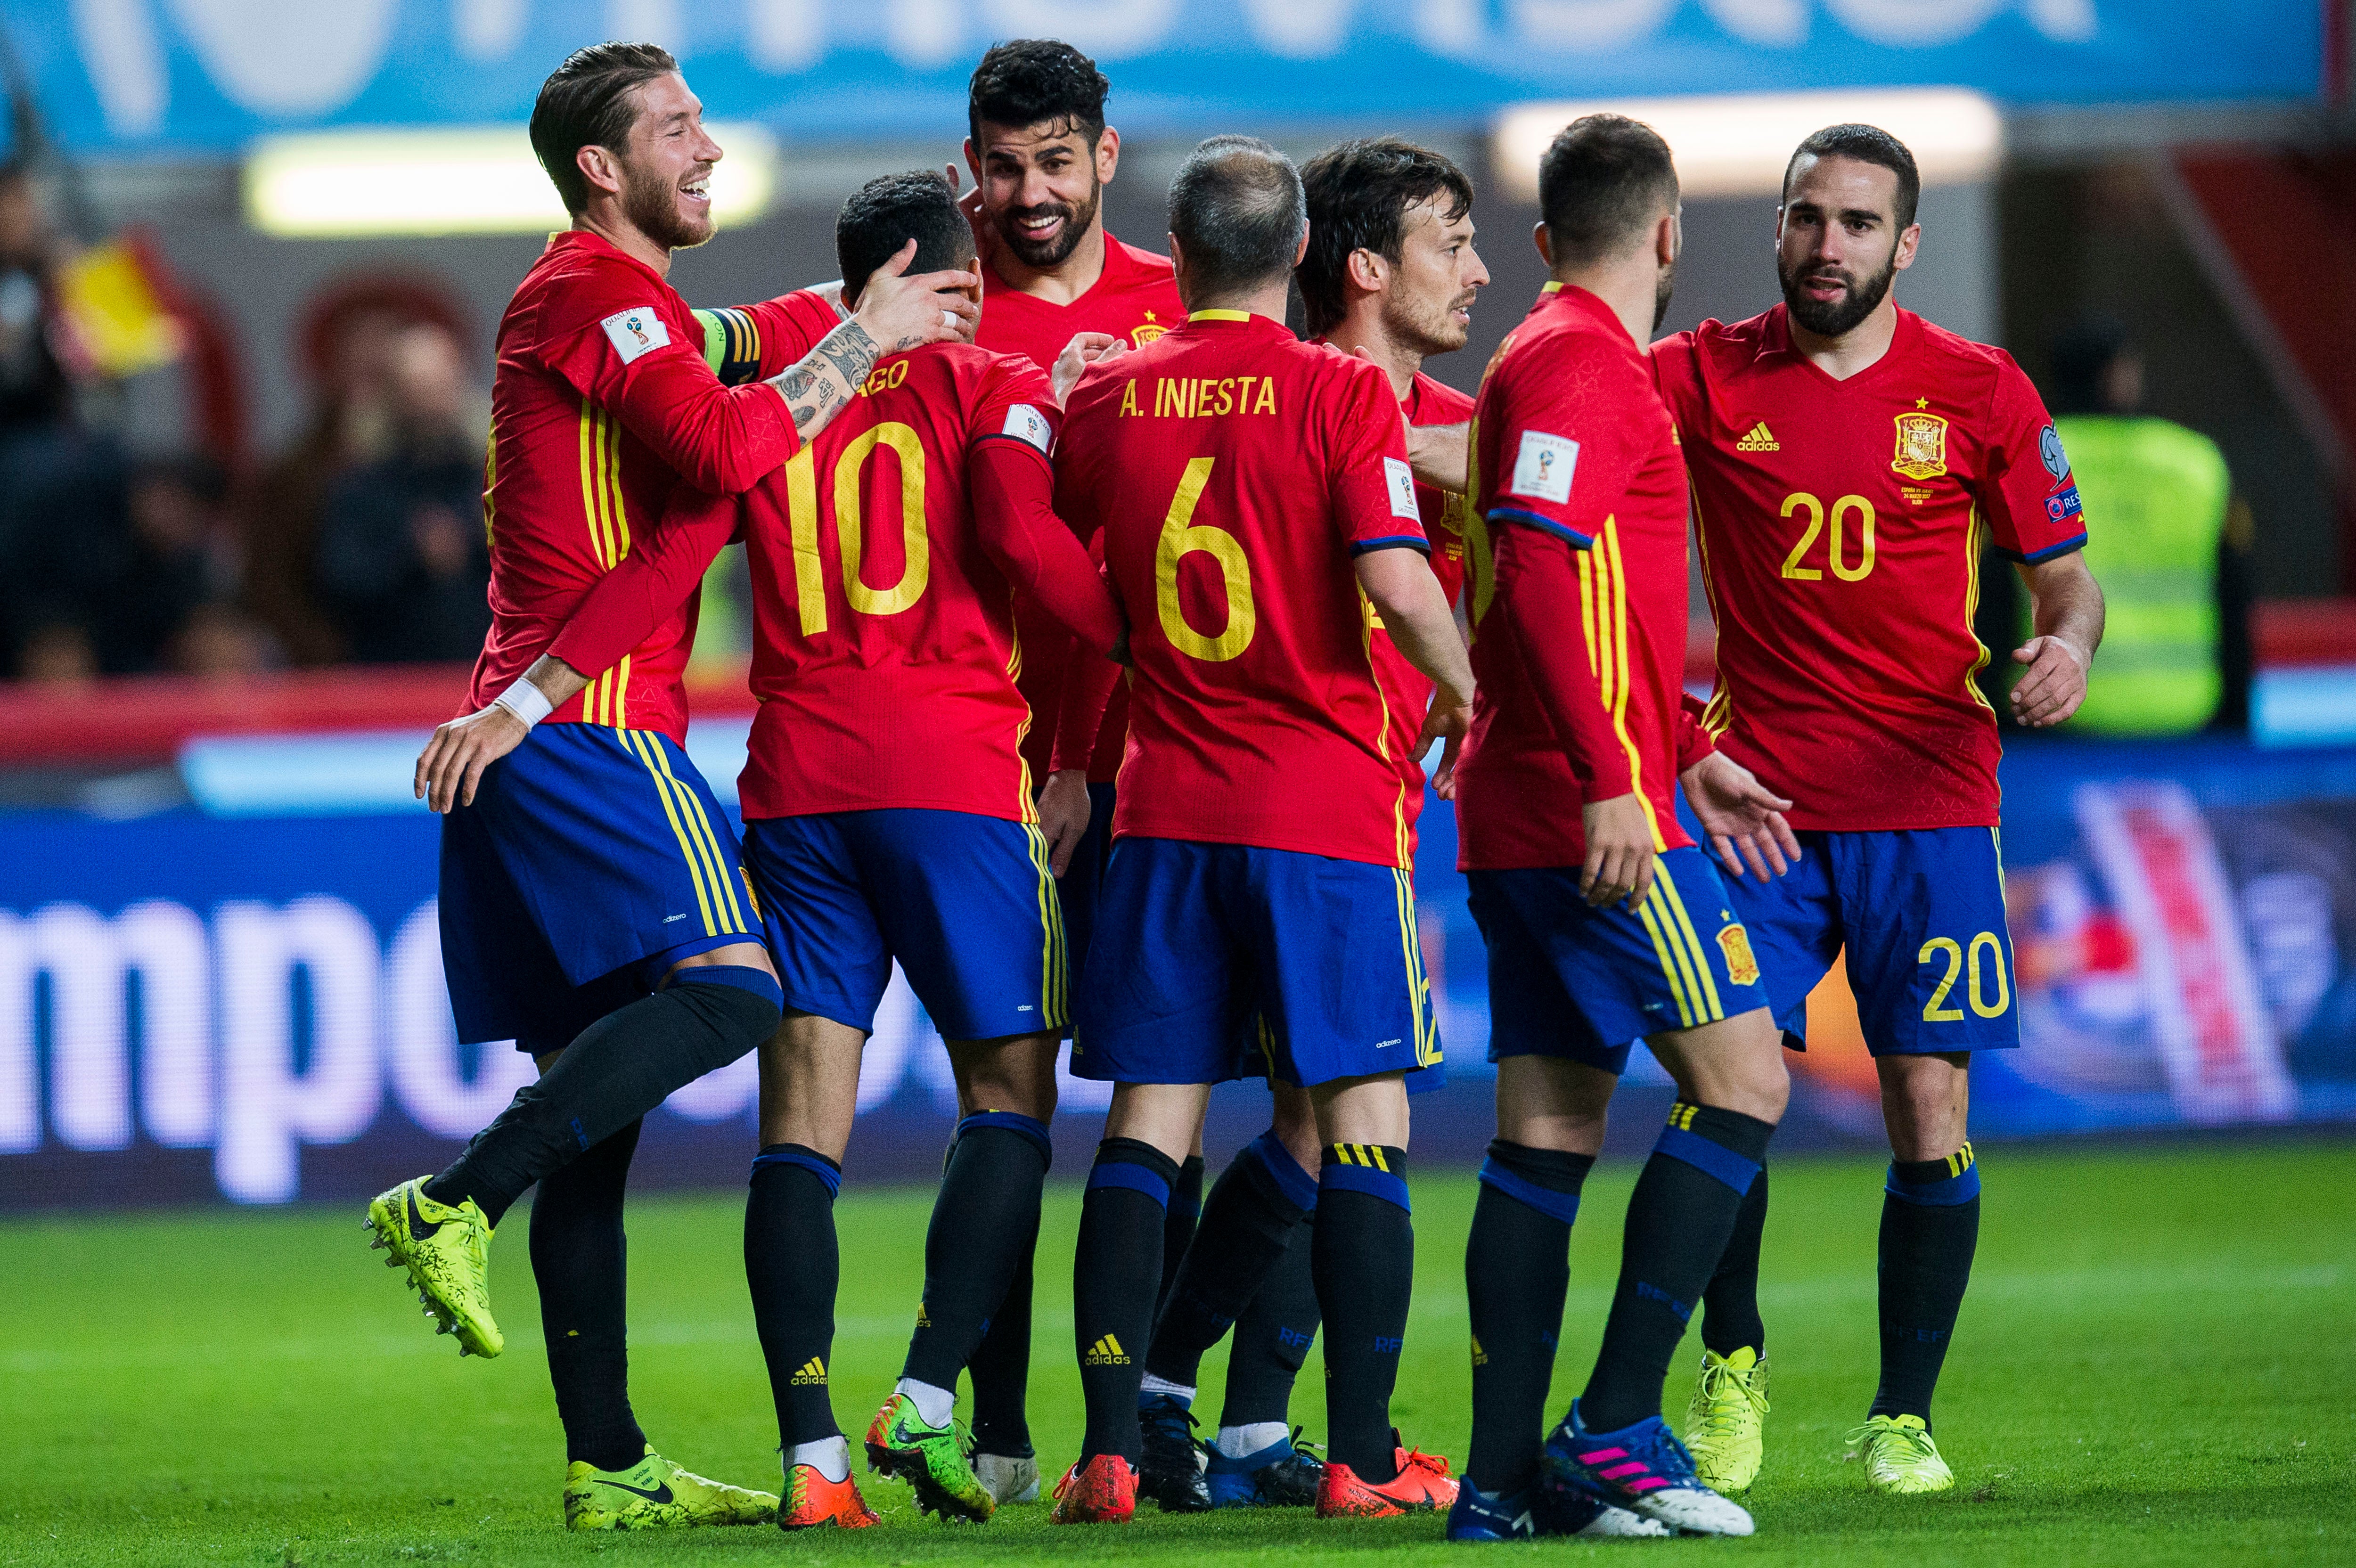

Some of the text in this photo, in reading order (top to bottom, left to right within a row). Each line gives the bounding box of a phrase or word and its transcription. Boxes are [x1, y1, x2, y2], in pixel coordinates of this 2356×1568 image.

[1119, 376, 1276, 418] A. INIESTA
[1736, 440, 1780, 451] adidas
[784, 421, 930, 637] 10
[1780, 491, 1875, 582] 20
[1155, 457, 1256, 662] 6
[1918, 931, 2010, 1021] 20
[1376, 1038, 1401, 1048] adizero
[425, 1203, 443, 1211] MARCO
[1085, 1354, 1130, 1365] adidas
[791, 1374, 827, 1385] adidas
